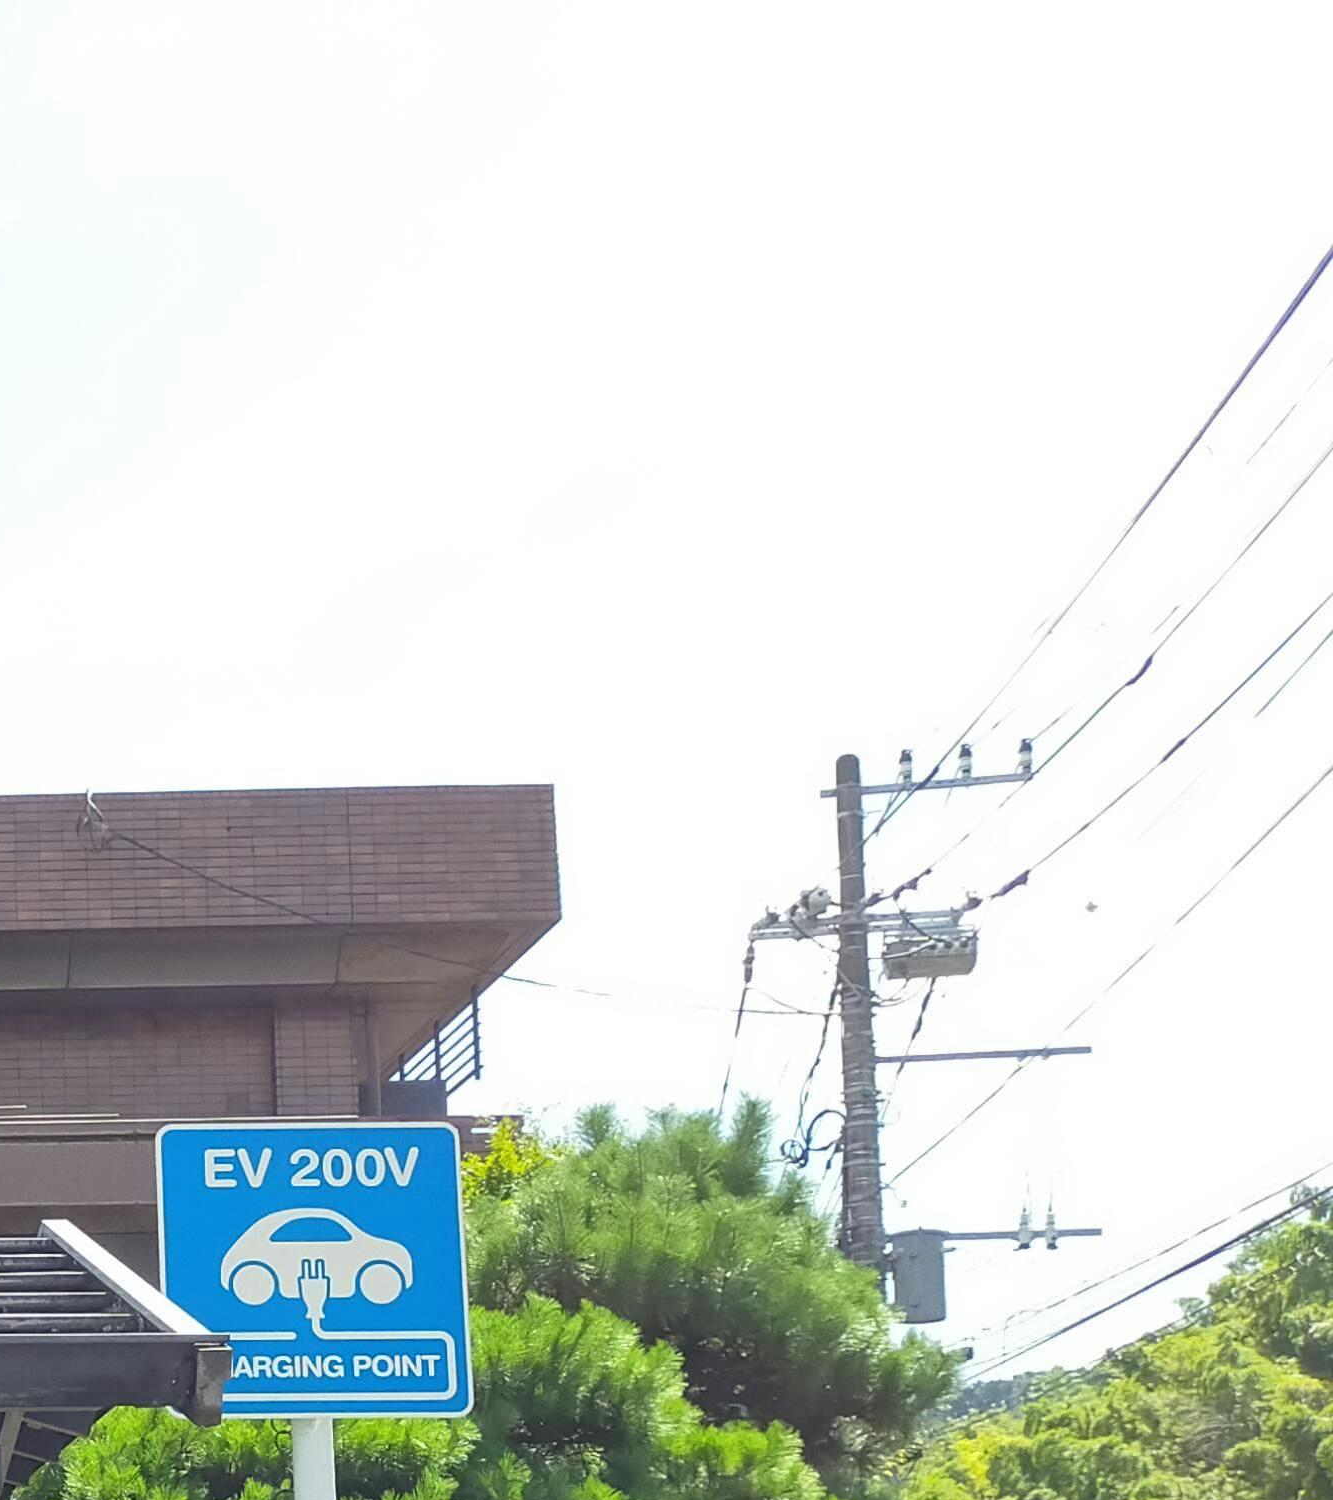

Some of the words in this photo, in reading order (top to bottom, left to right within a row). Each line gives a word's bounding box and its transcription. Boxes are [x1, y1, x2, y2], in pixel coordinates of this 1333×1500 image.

[204, 1147, 273, 1189] EV
[289, 1146, 420, 1188] 200V
[230, 1354, 345, 1379] ARGING
[352, 1354, 441, 1378] POINT
